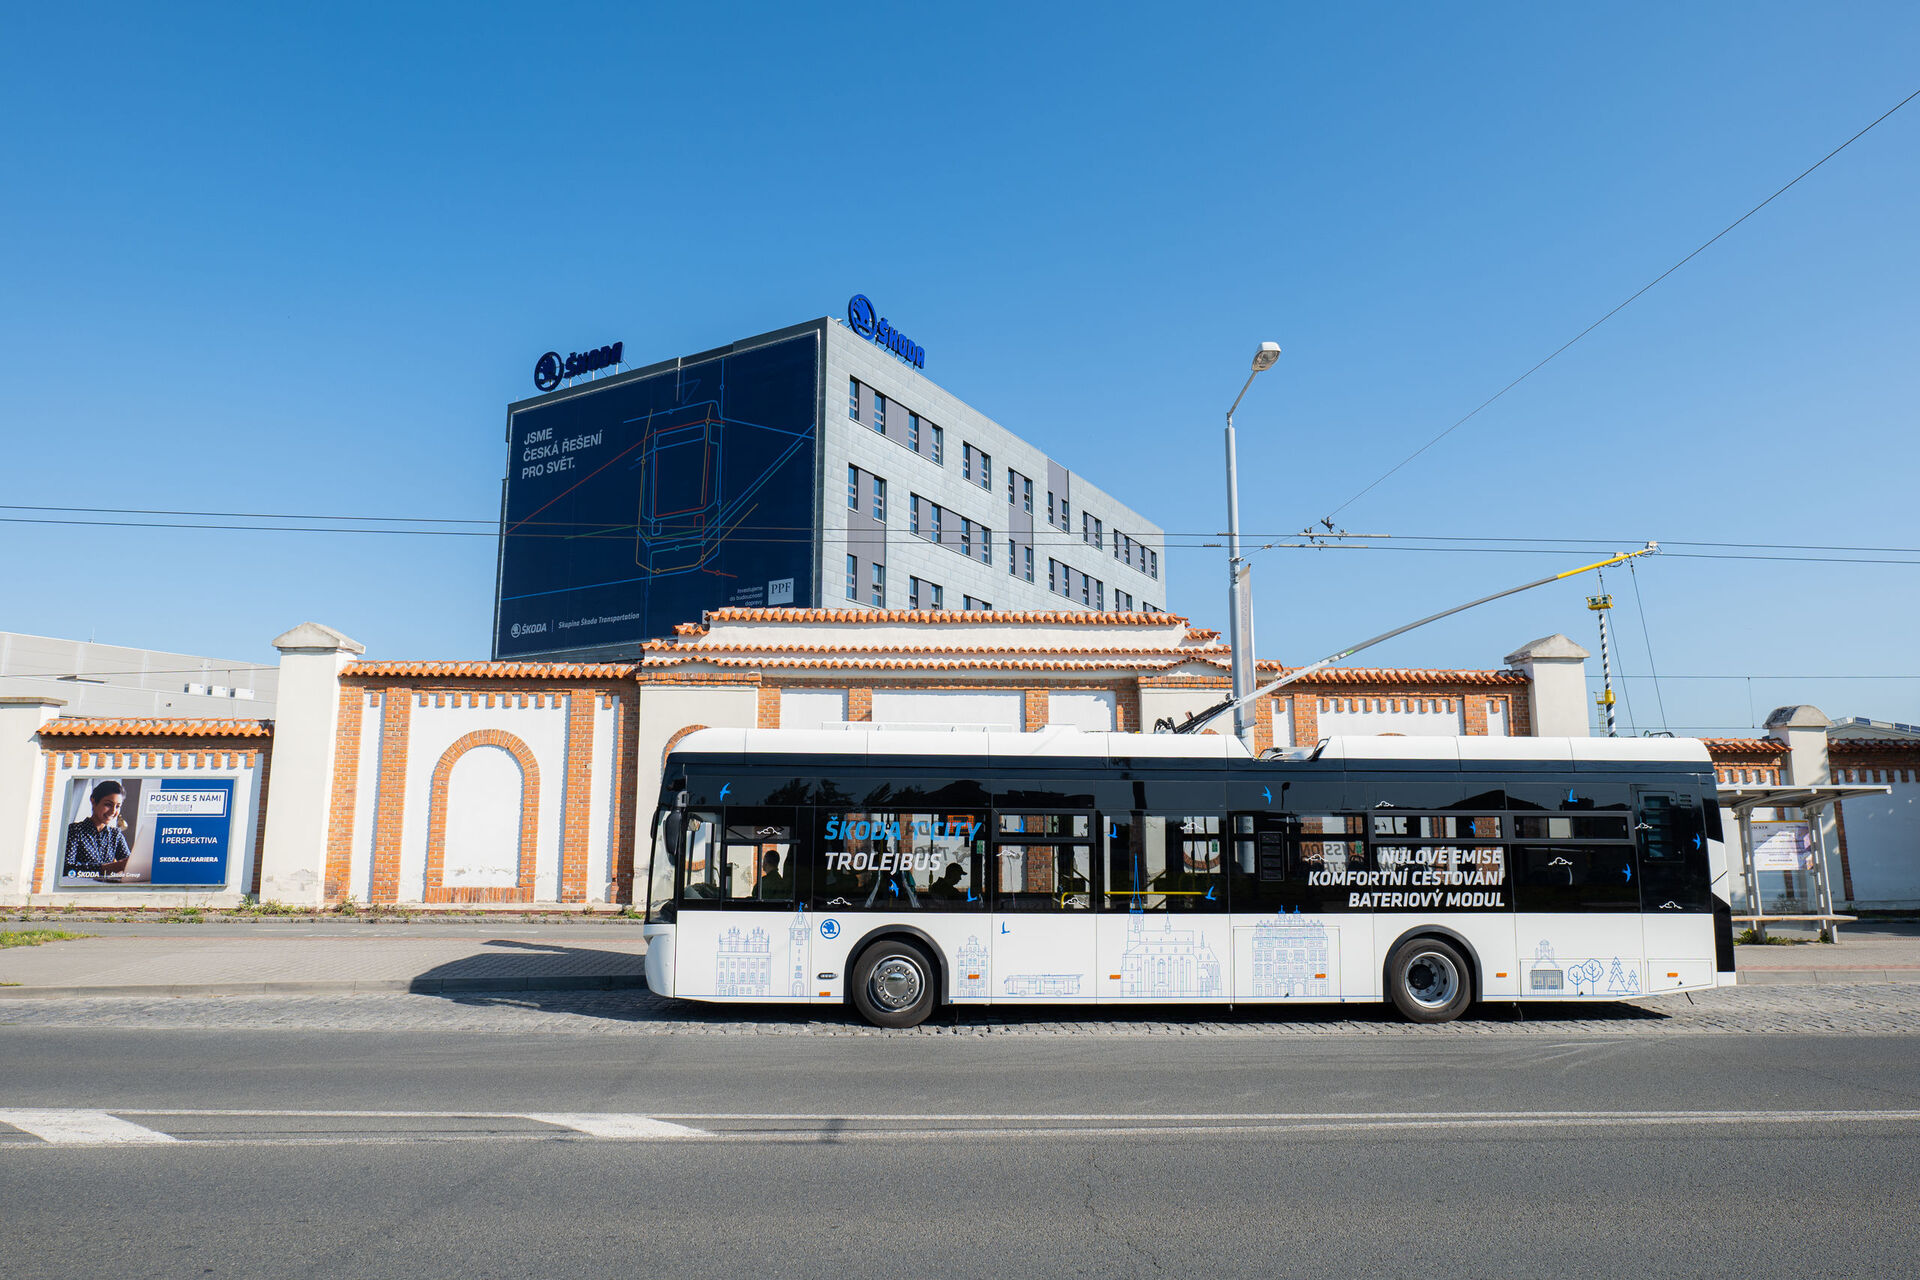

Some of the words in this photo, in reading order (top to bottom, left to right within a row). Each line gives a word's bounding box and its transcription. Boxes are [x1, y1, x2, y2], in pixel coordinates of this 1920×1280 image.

[876, 317, 925, 369] ŠKODA
[563, 341, 623, 378] ŠKODA
[523, 427, 553, 446] JSME
[523, 440, 559, 462] ČESKÁ
[561, 429, 603, 454] ŘEŠENÍ
[521, 464, 544, 480] PRO
[546, 455, 576, 474] SVĚT.
[771, 582, 792, 594] PPF
[521, 622, 547, 635] ŠKODA
[558, 620, 581, 630] Skupina
[581, 617, 598, 626] Škoda
[599, 612, 640, 625] Transportation
[150, 793, 178, 802] POSUŇ
[180, 794, 190, 802] SE
[192, 794, 198, 802] S
[199, 793, 221, 802] NÁMI
[161, 827, 193, 836] JISTOTA
[824, 816, 901, 841] ŠKODA
[165, 836, 218, 844] PERSPEKTIVA
[825, 852, 942, 876] TROLEJBUS
[1380, 846, 1448, 865] NULOVÉ
[1451, 849, 1502, 864] EMISE
[77, 870, 100, 879] ŠKODA
[1308, 867, 1409, 886] KOMFORTNÍ
[1412, 866, 1504, 886] CESTOVÁNÍ
[1348, 888, 1443, 908] BATERIOVÝ
[1446, 892, 1505, 907] MODUL
